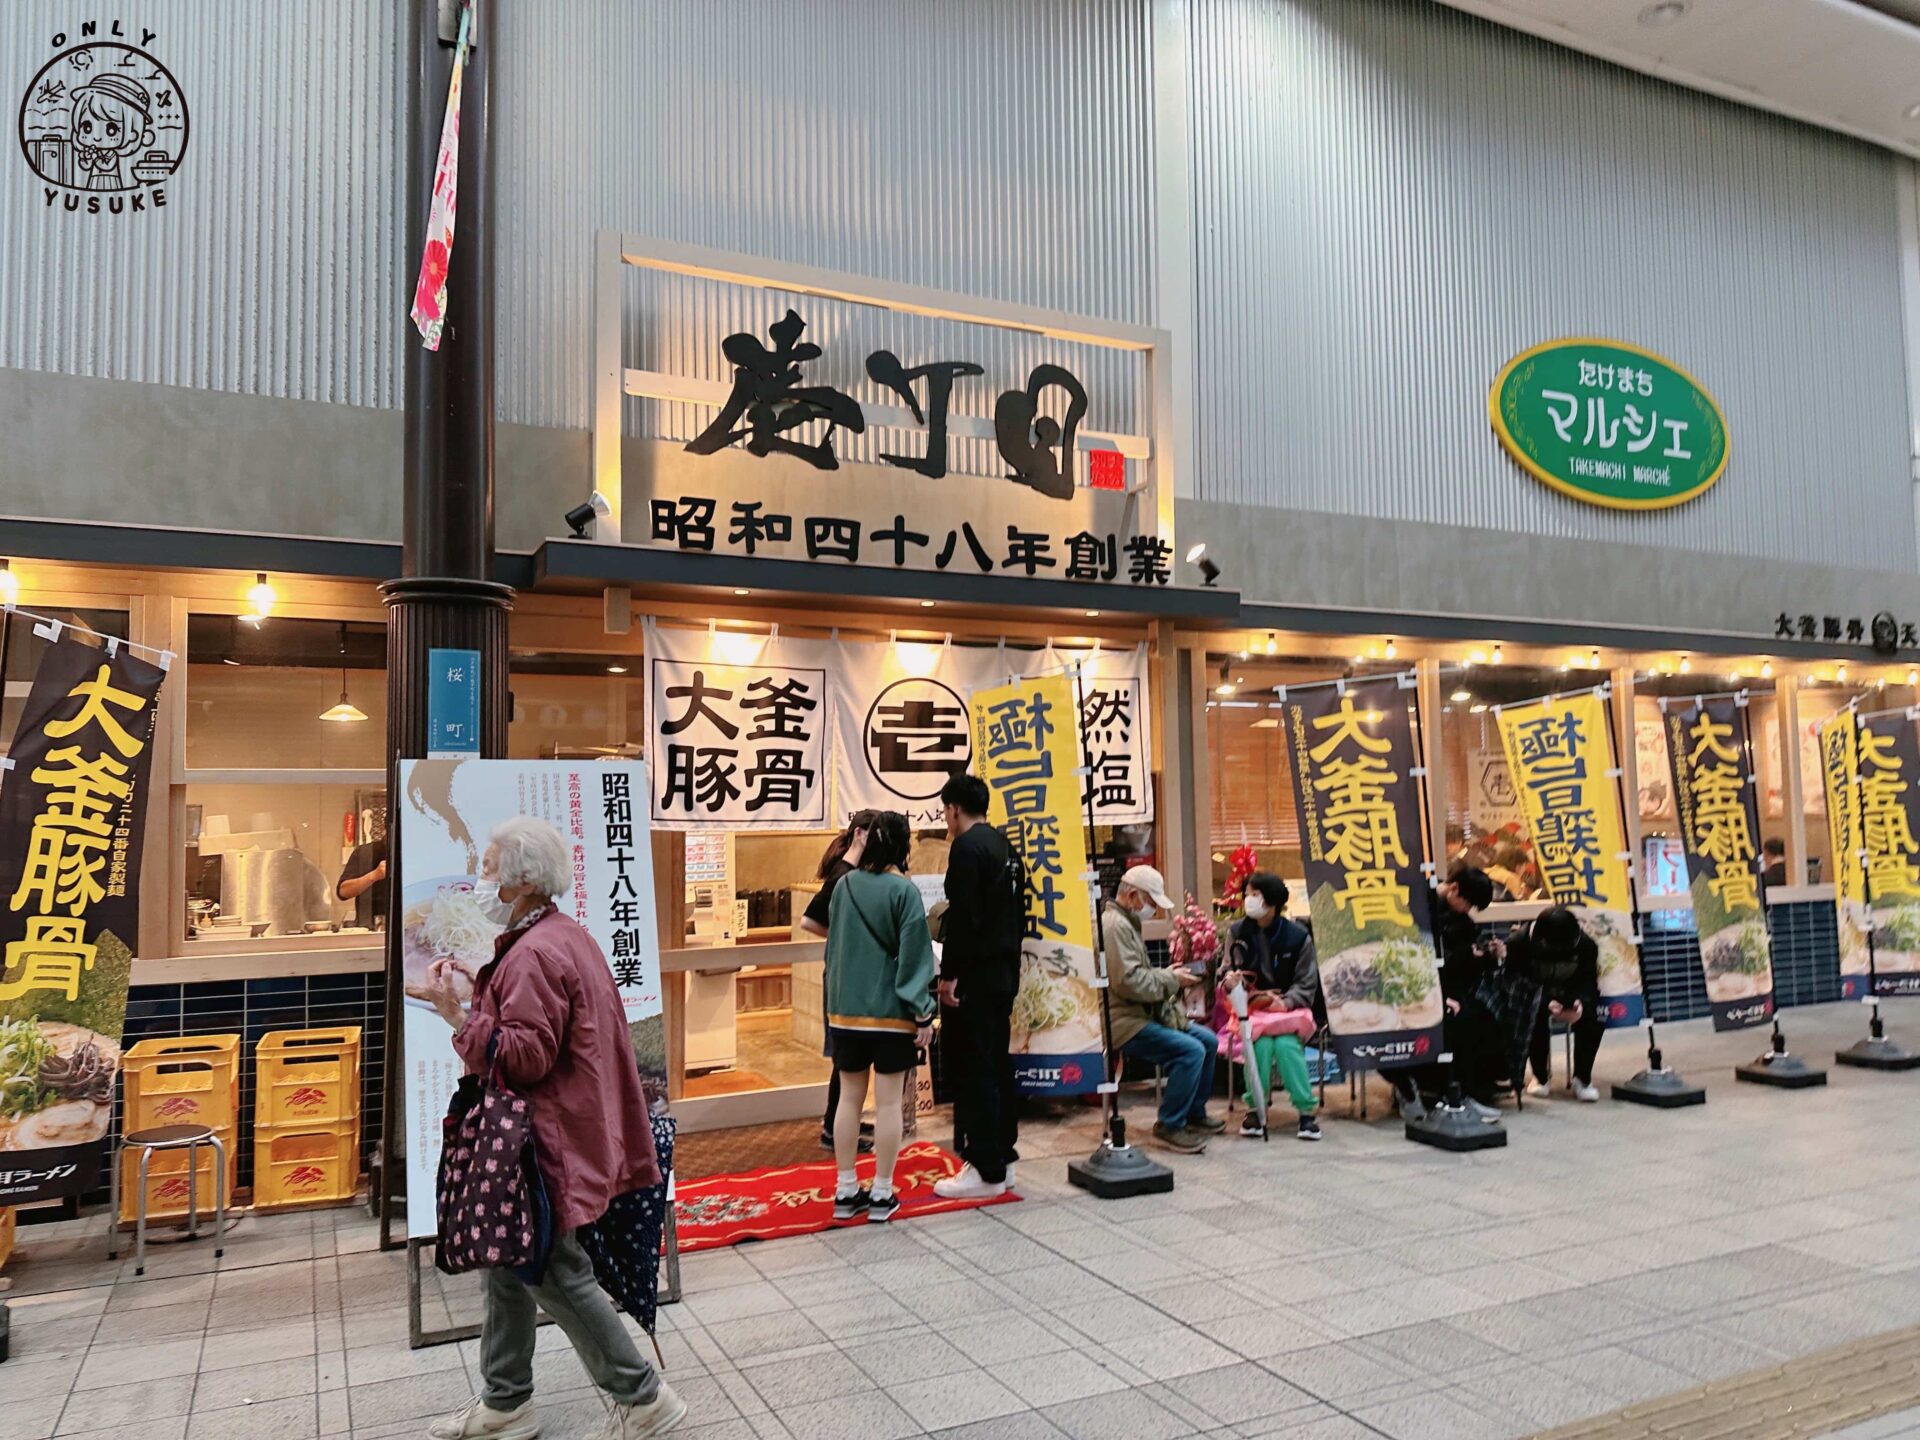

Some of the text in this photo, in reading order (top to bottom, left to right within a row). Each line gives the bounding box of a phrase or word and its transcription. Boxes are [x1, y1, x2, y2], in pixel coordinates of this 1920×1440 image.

[1578, 358, 1653, 396] たけまち
[1542, 389, 1692, 460] マルシェ
[1568, 456, 1671, 487] TAKEMACHI MARCHÉ
[650, 496, 1174, 584] 昭和四十八年創業
[661, 670, 818, 742] 大釜
[661, 743, 815, 813] 豚骨
[0, 663, 147, 1002] 大釜豚骨
[602, 773, 644, 988] 昭和四十八年創業
